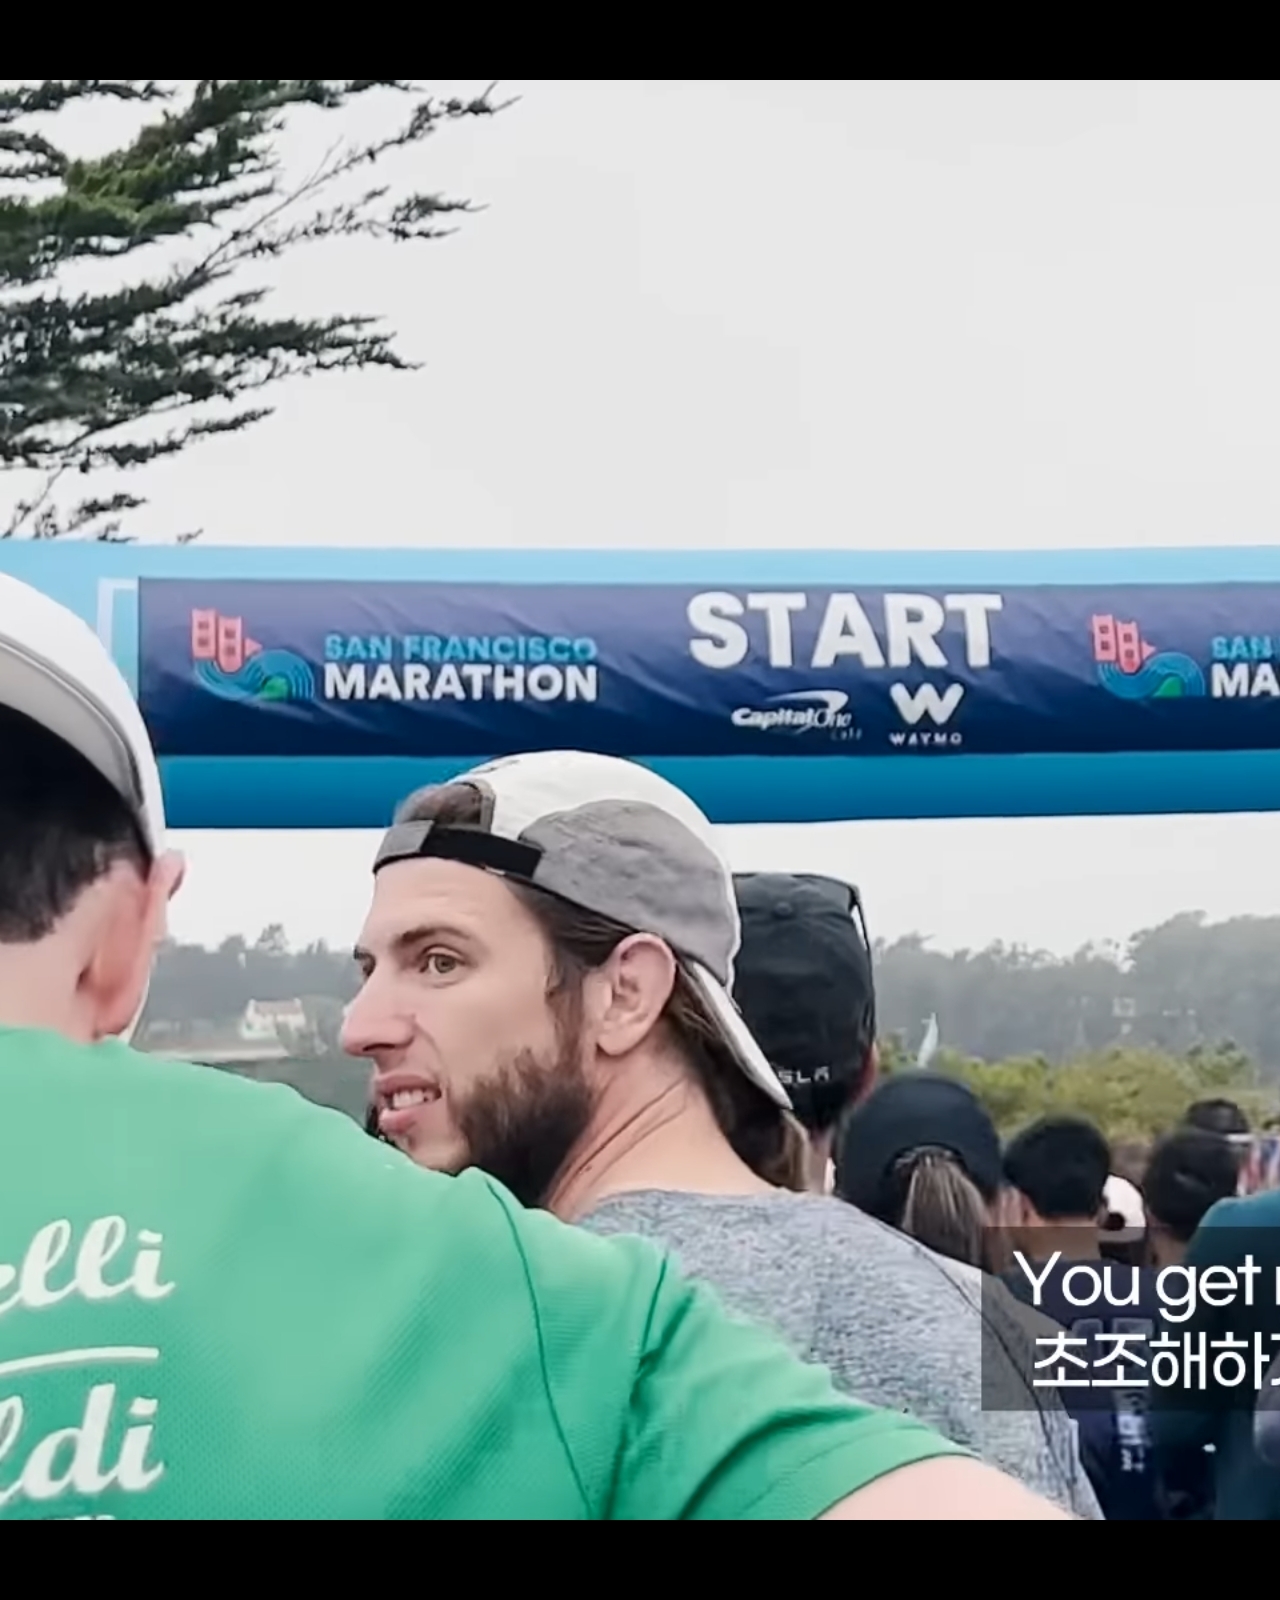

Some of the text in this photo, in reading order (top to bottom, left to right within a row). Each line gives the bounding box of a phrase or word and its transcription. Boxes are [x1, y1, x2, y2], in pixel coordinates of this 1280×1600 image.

[686, 591, 1003, 669] START
[325, 634, 598, 661] SAN FRANCISCO
[1211, 635, 1271, 660] SAN
[324, 663, 599, 701] MARATHON
[889, 731, 963, 746] WAYMO
[777, 1065, 830, 1085] SLA
